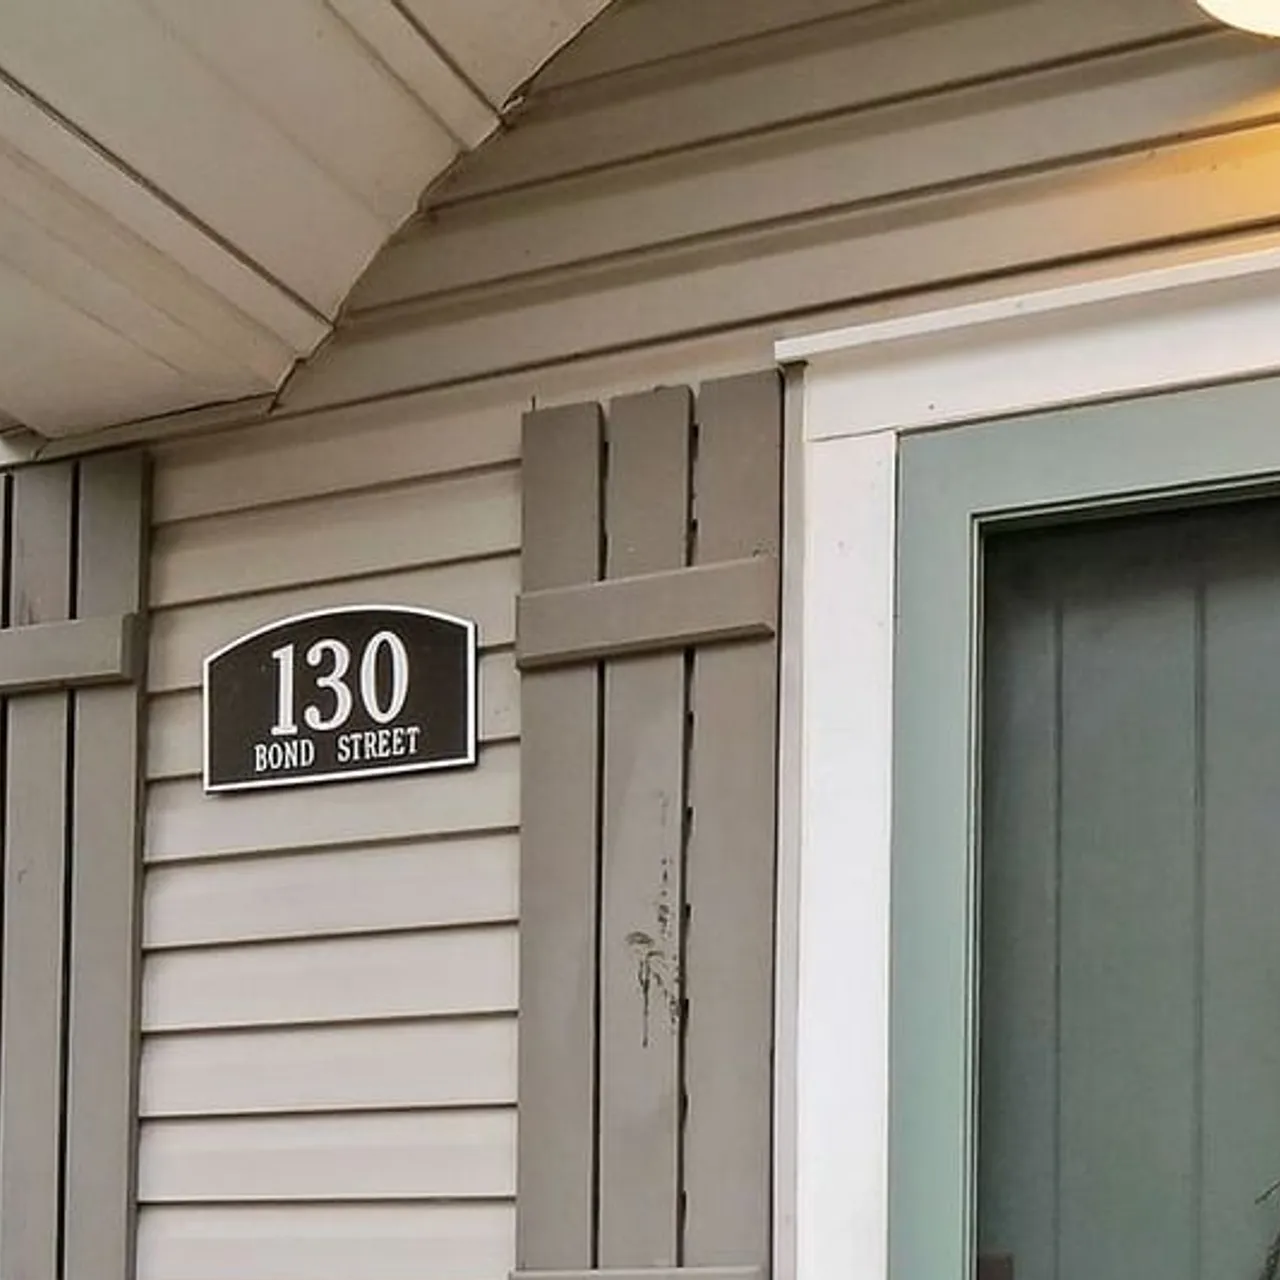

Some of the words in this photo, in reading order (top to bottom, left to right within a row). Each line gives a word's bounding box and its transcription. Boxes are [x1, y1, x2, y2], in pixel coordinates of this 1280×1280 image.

[271, 630, 409, 736] 130
[254, 739, 315, 772] BOND
[337, 727, 420, 762] STREET
